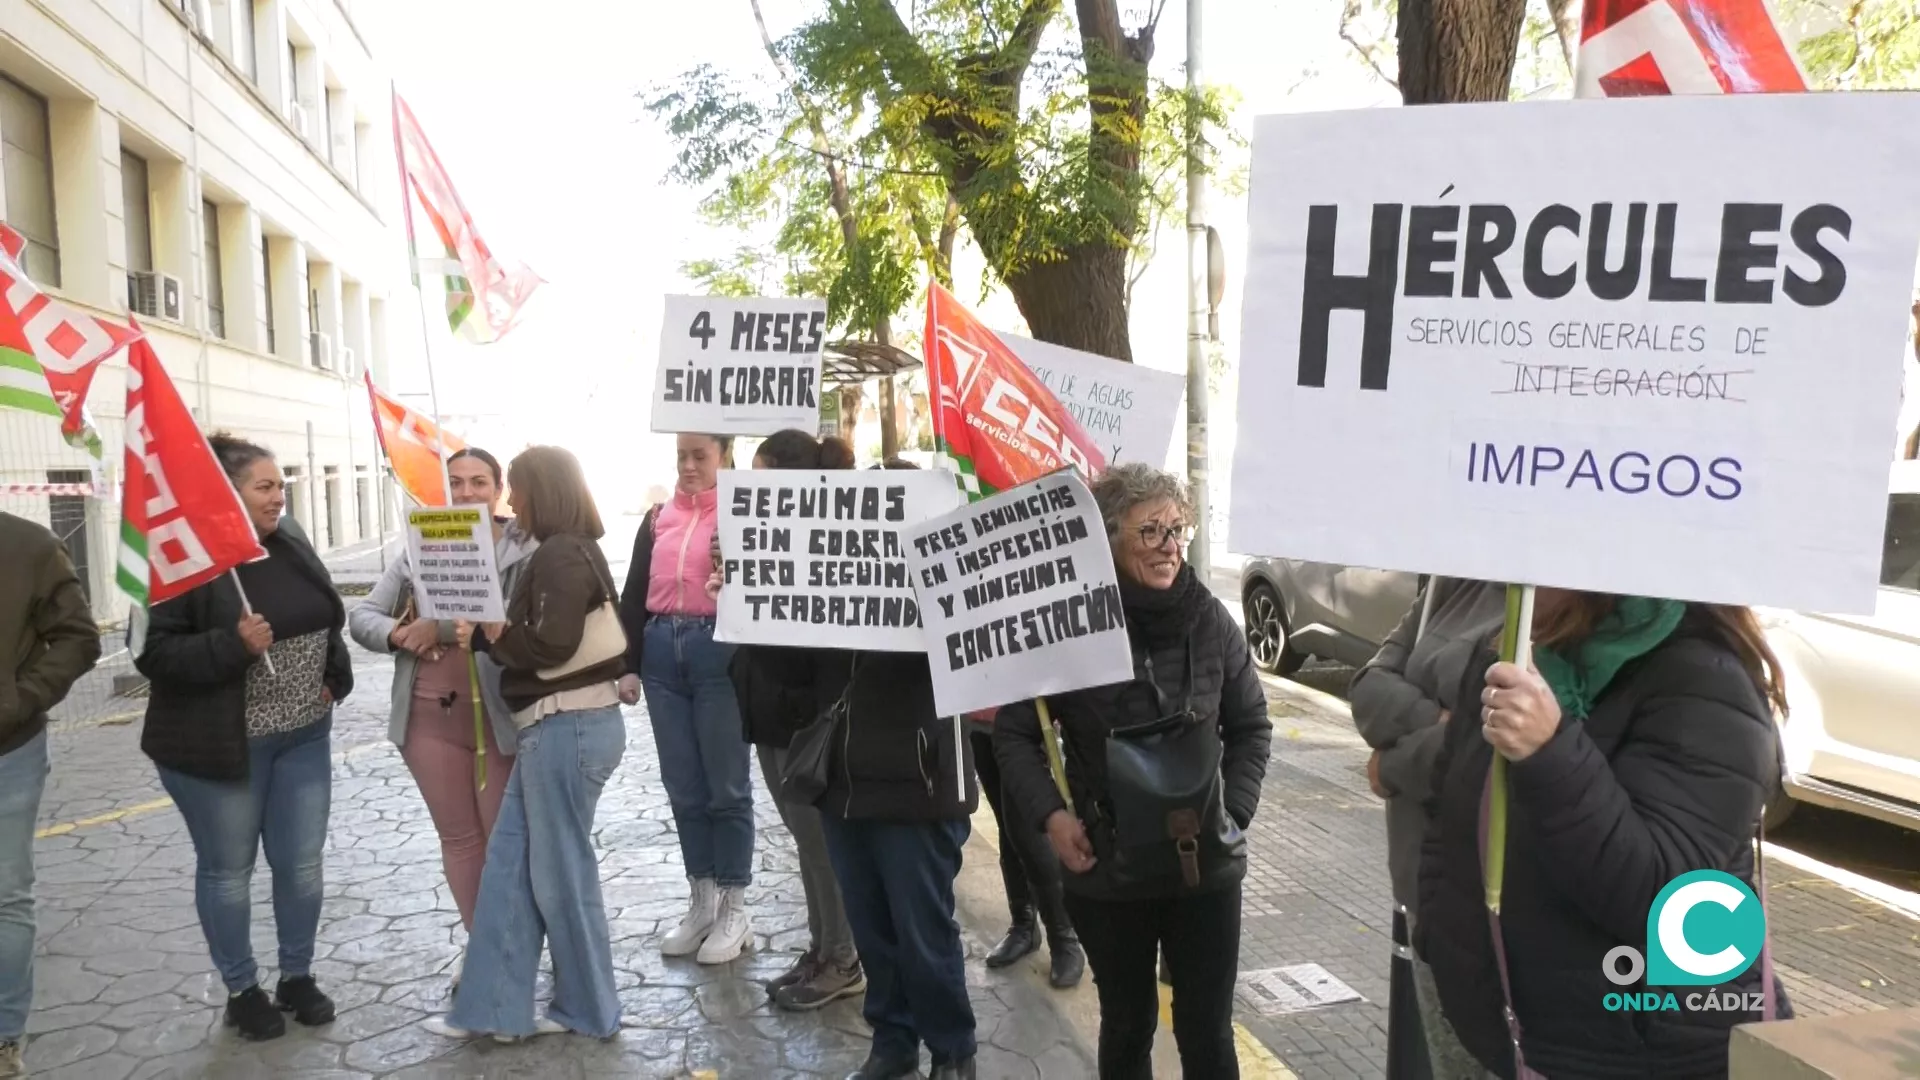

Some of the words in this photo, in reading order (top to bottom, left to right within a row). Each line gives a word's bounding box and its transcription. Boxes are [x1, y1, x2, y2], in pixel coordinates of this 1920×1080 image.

[1298, 184, 1853, 391] HÉRCULES
[689, 311, 716, 350] 4
[730, 311, 826, 354] MESES
[1406, 317, 1533, 348] SERVICIOS
[1548, 322, 1706, 353] GENERALES
[1735, 327, 1769, 355] DE
[720, 365, 816, 408] COBRAR
[1088, 381, 1135, 410] AGUAS
[1512, 364, 1728, 400] INTEGRACIÓN
[1467, 442, 1744, 501] IMPAGOS
[808, 528, 906, 558] COBRA
[914, 522, 968, 558] TRES
[725, 559, 795, 587] PERO
[921, 563, 948, 588] EN
[745, 594, 923, 628] TRABAJAND
[937, 594, 954, 618] Y
